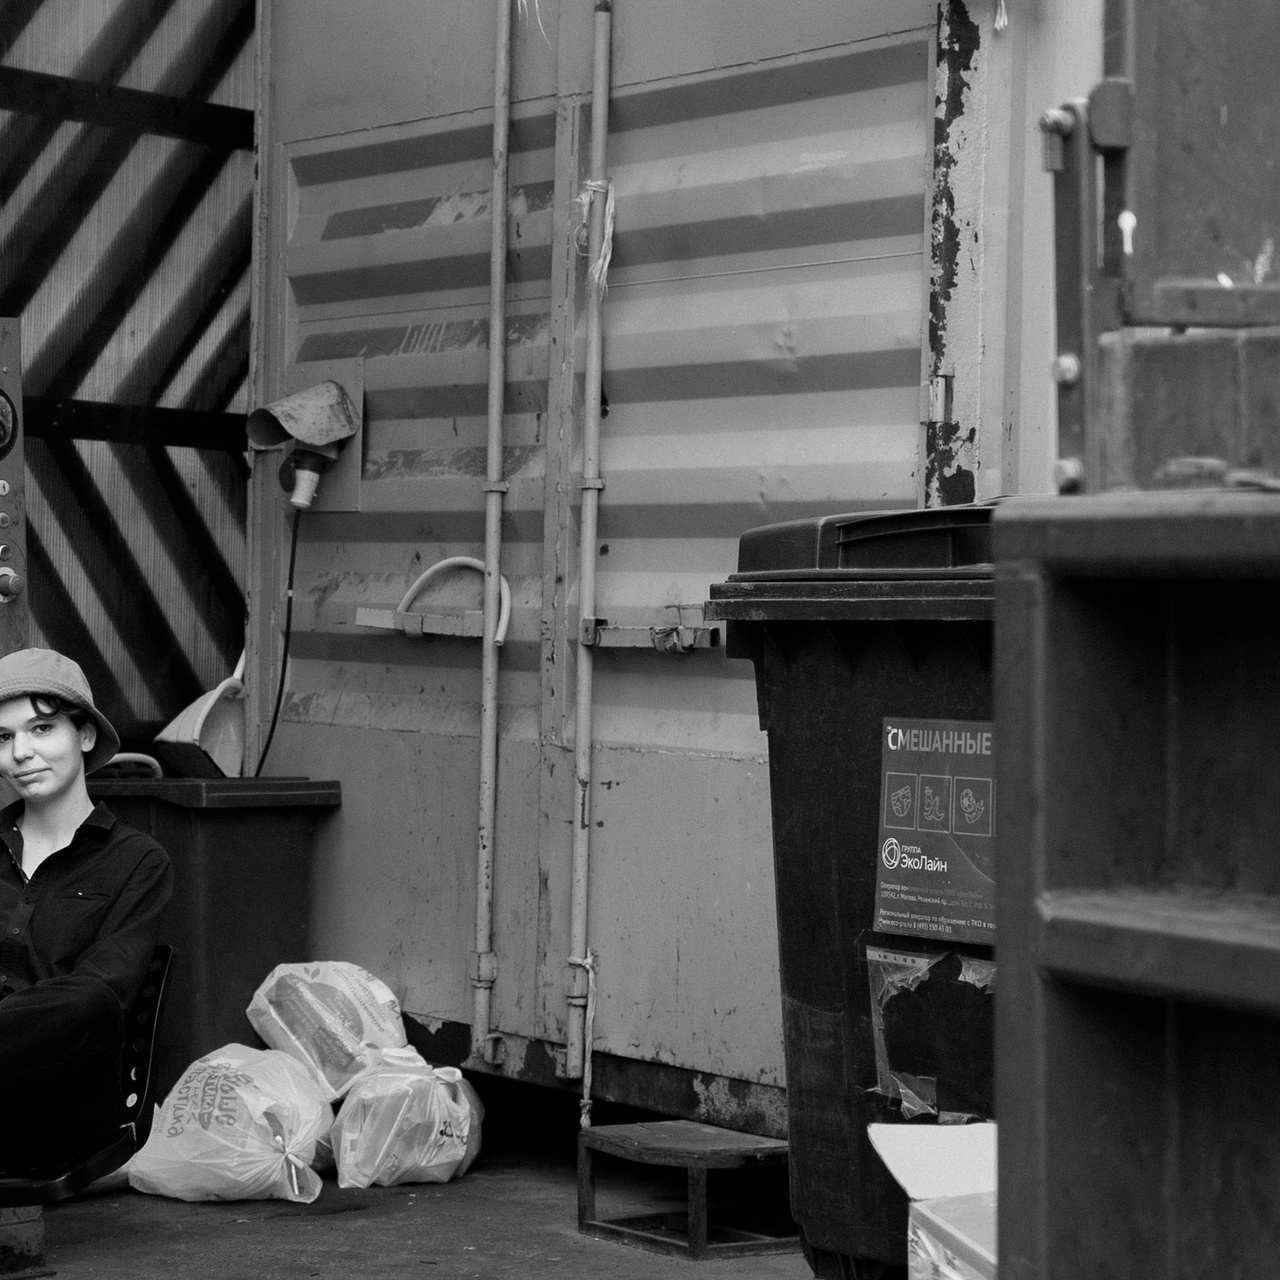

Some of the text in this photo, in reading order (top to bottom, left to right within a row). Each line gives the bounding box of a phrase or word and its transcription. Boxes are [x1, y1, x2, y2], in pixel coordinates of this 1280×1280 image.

[887, 728, 992, 755] СМЕШАННЫЕ
[901, 845, 922, 854] ГРУППА
[900, 853, 948, 872] ЭкоЛайн
